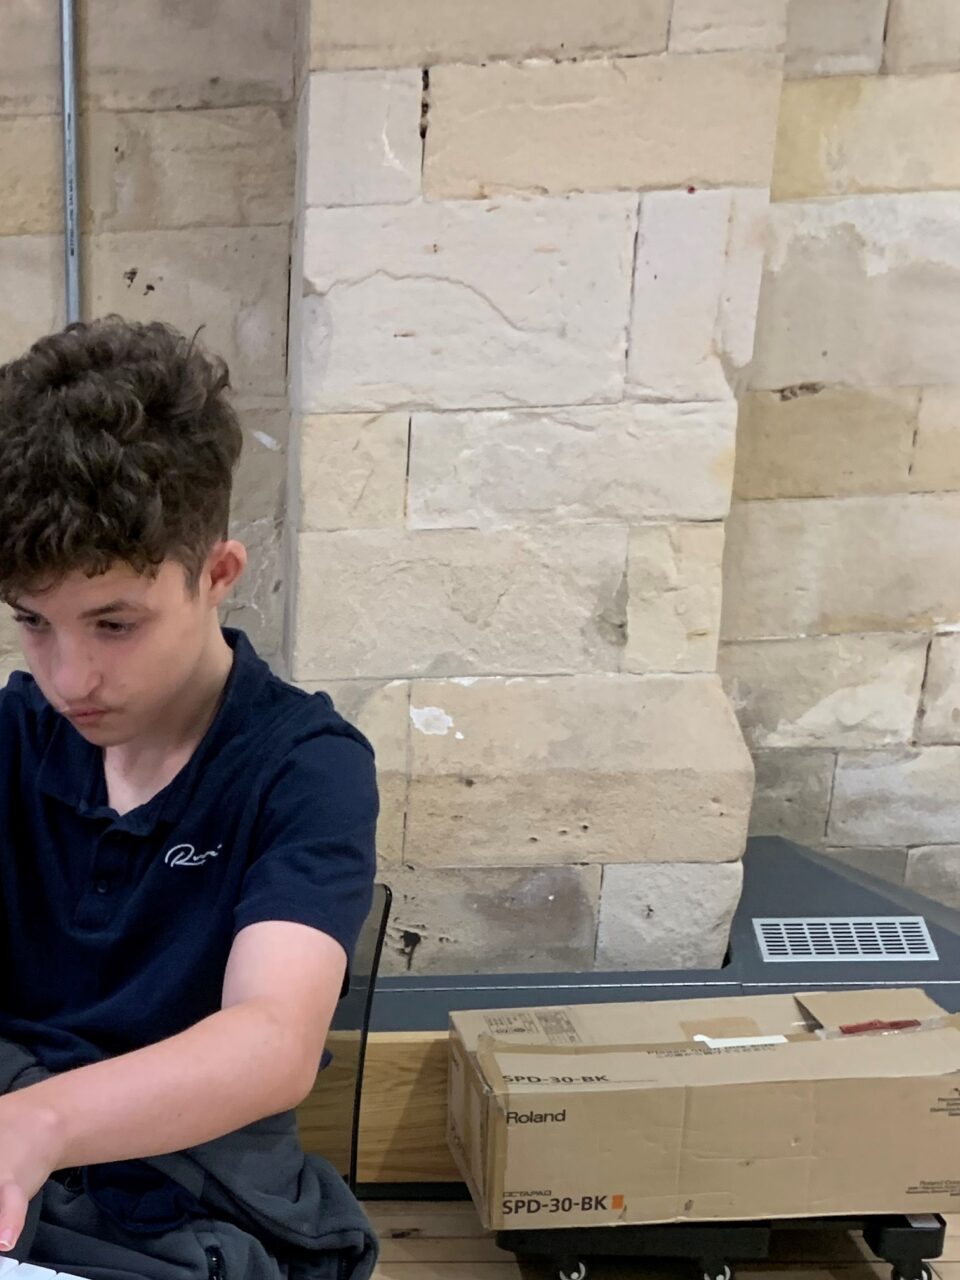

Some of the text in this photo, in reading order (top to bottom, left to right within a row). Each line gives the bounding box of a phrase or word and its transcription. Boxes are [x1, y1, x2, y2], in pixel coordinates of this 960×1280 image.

[502, 1075, 609, 1083] SPD-30-BK
[506, 1109, 566, 1124] Roland
[502, 1195, 608, 1215] SPD-30-BK
